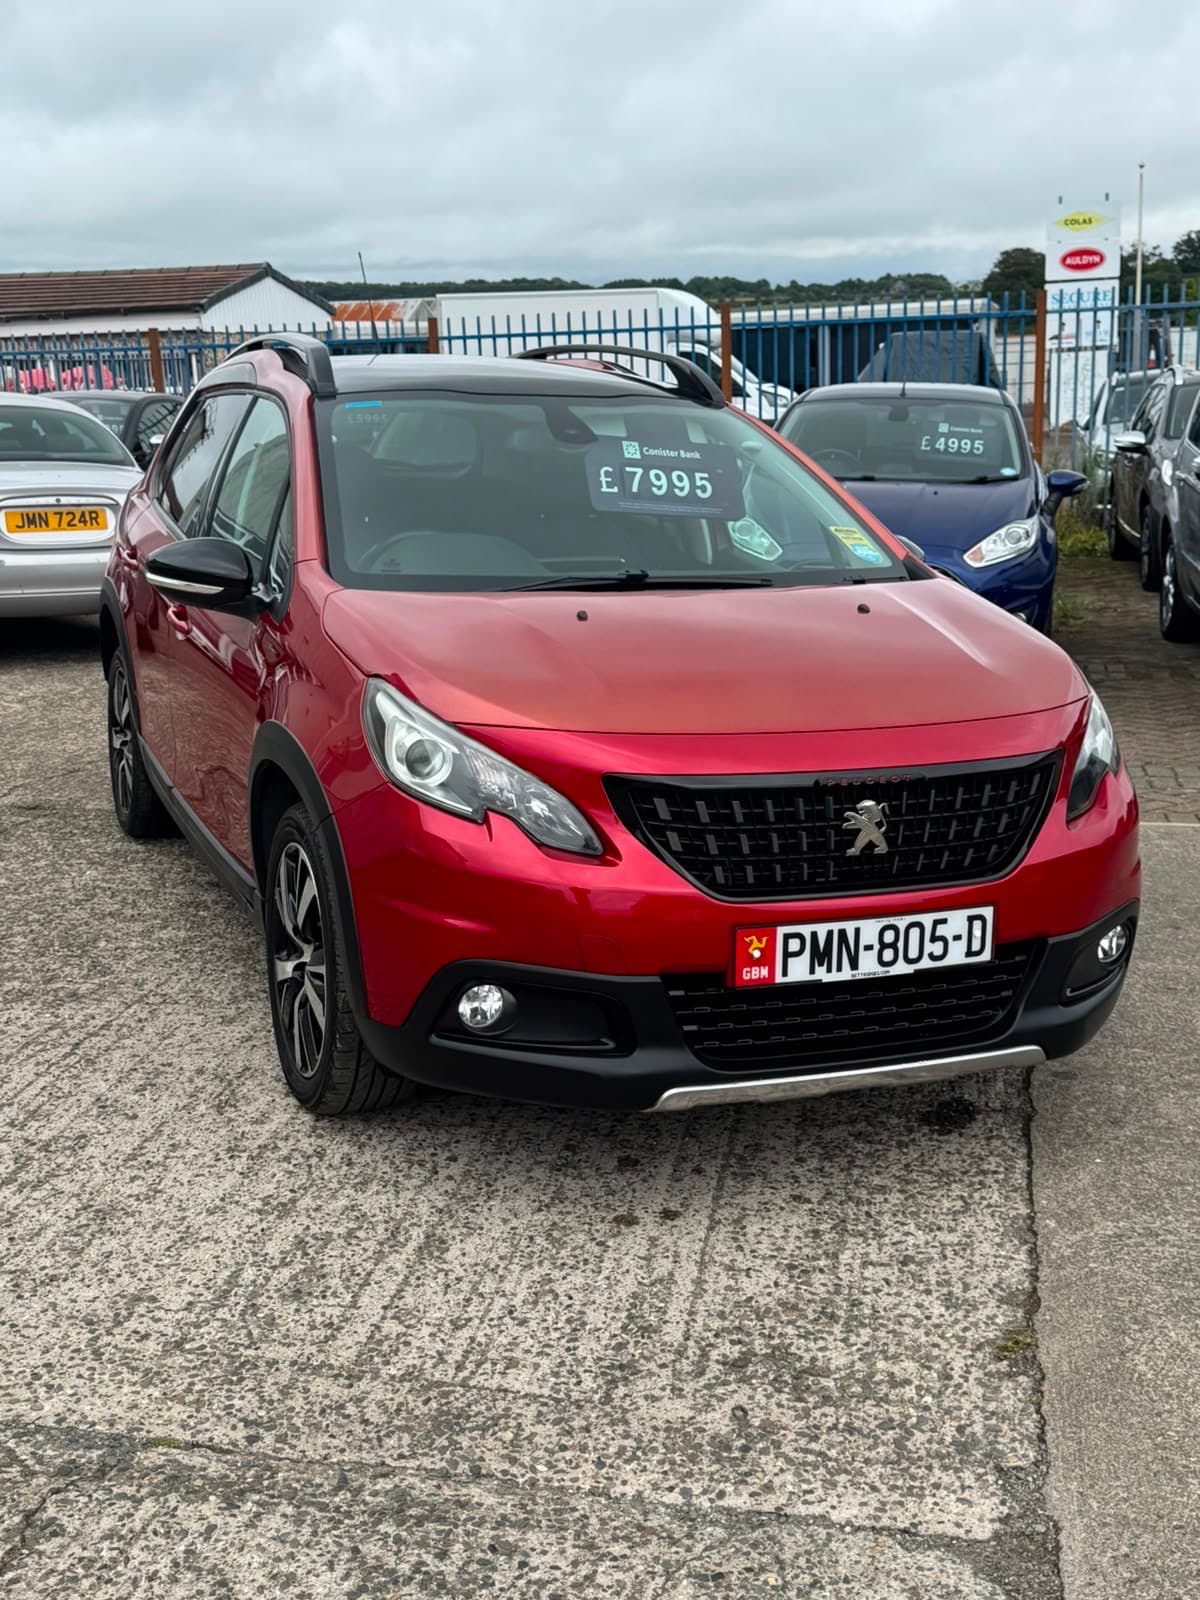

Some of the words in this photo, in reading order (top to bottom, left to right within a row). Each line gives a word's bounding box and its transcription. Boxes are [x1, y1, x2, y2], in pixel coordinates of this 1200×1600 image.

[1064, 217, 1093, 226] COLAS
[1065, 254, 1101, 266] AULDYN
[642, 446, 678, 458] Conister
[679, 449, 702, 459] Bank
[920, 435, 985, 455] £4995
[599, 466, 713, 499] £7995
[16, 511, 50, 529] JMN
[53, 510, 100, 528] 724R
[826, 774, 912, 787] PEUGEOT
[781, 913, 988, 978] PMN-805-D
[742, 965, 769, 980] GBM
